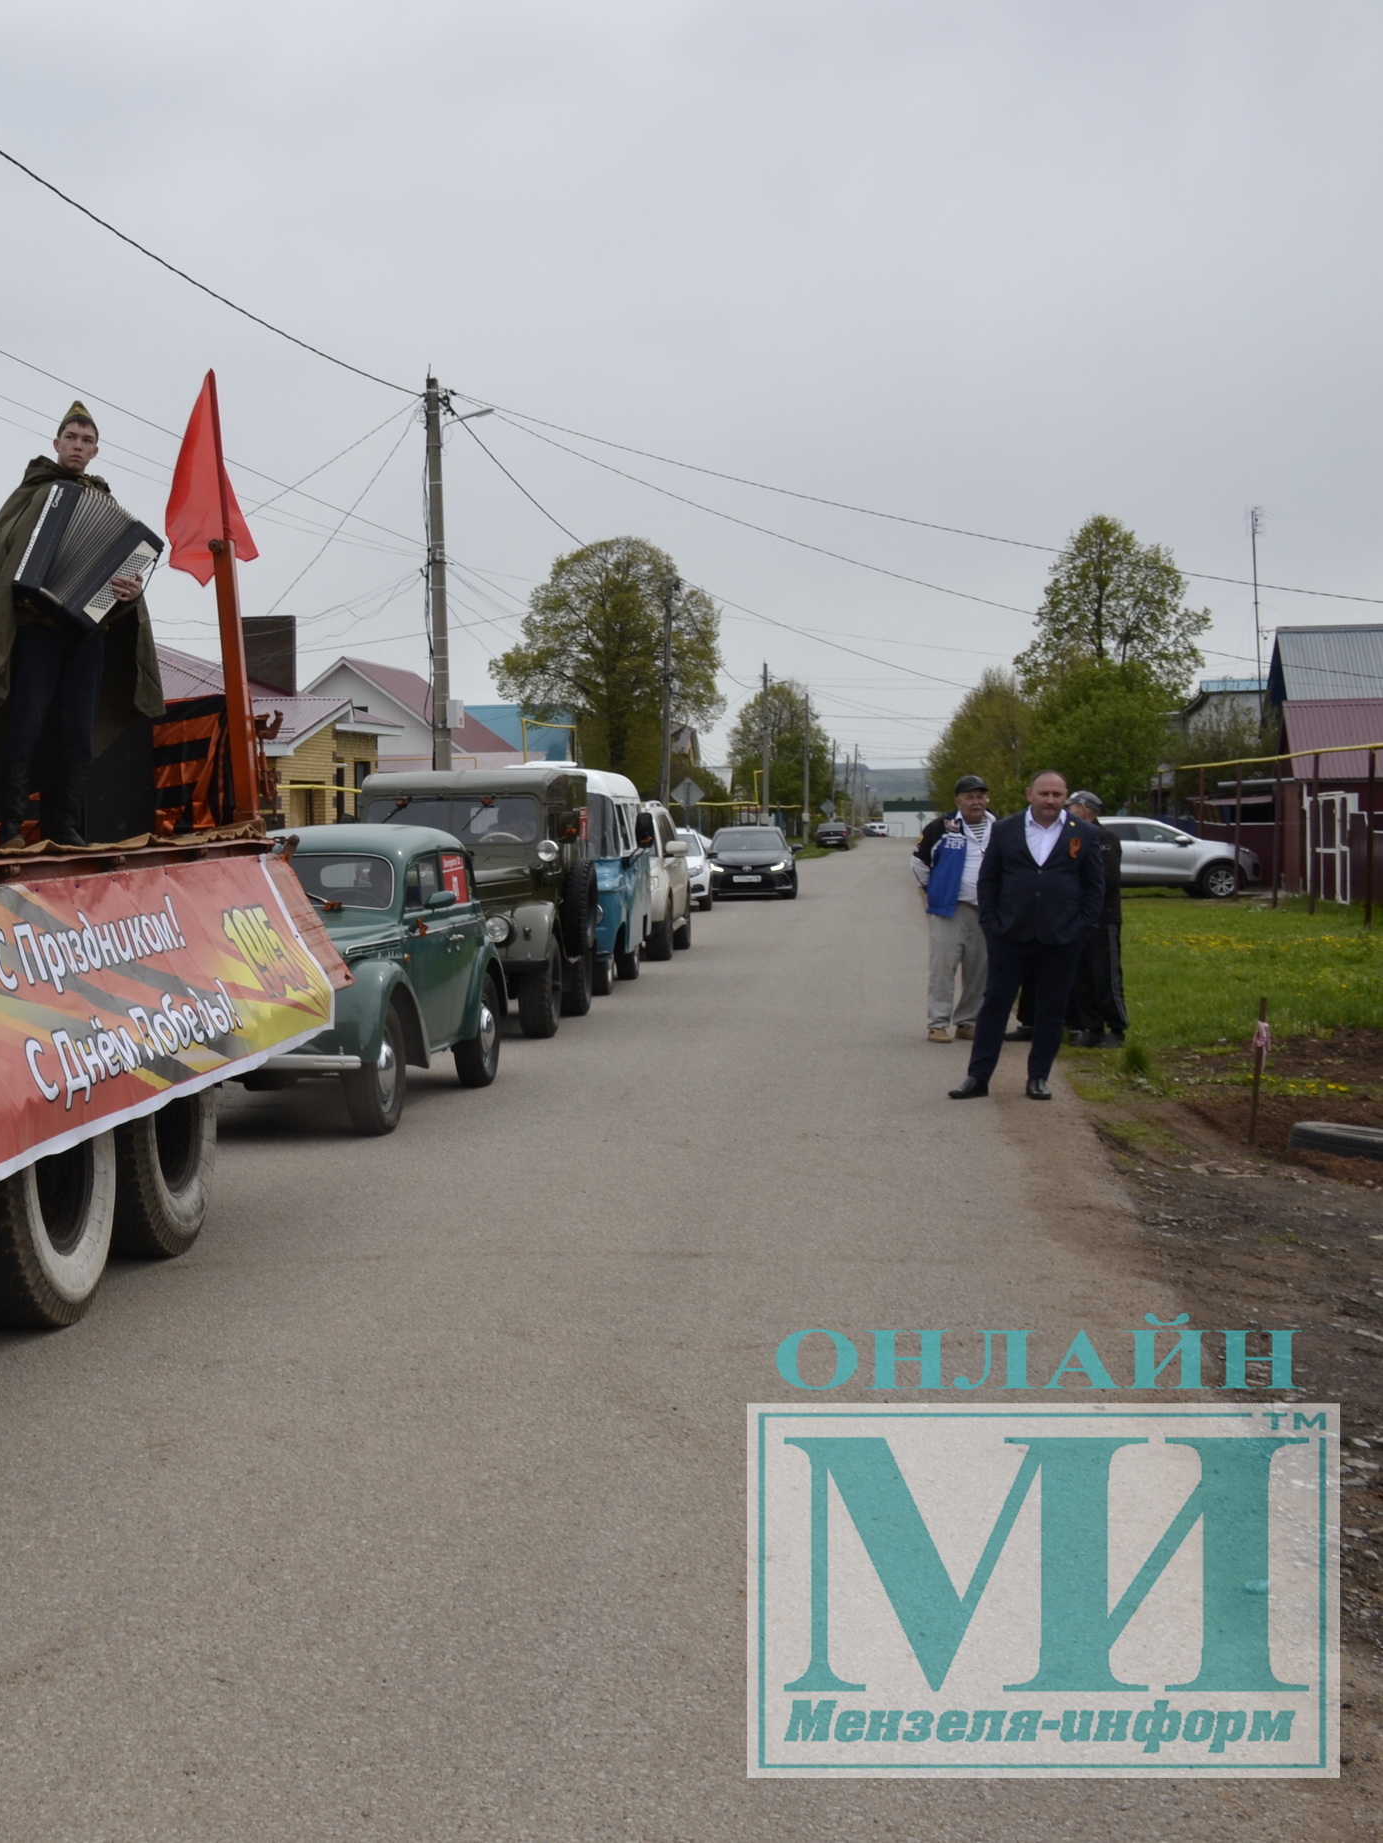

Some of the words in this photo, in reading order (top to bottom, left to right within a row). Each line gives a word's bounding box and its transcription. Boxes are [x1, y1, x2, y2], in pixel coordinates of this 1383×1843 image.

[13, 894, 187, 994] Праздником!
[221, 904, 309, 999] 1945
[24, 1037, 60, 1102] С
[51, 1015, 142, 1110] Днём
[128, 977, 243, 1060] Победы!
